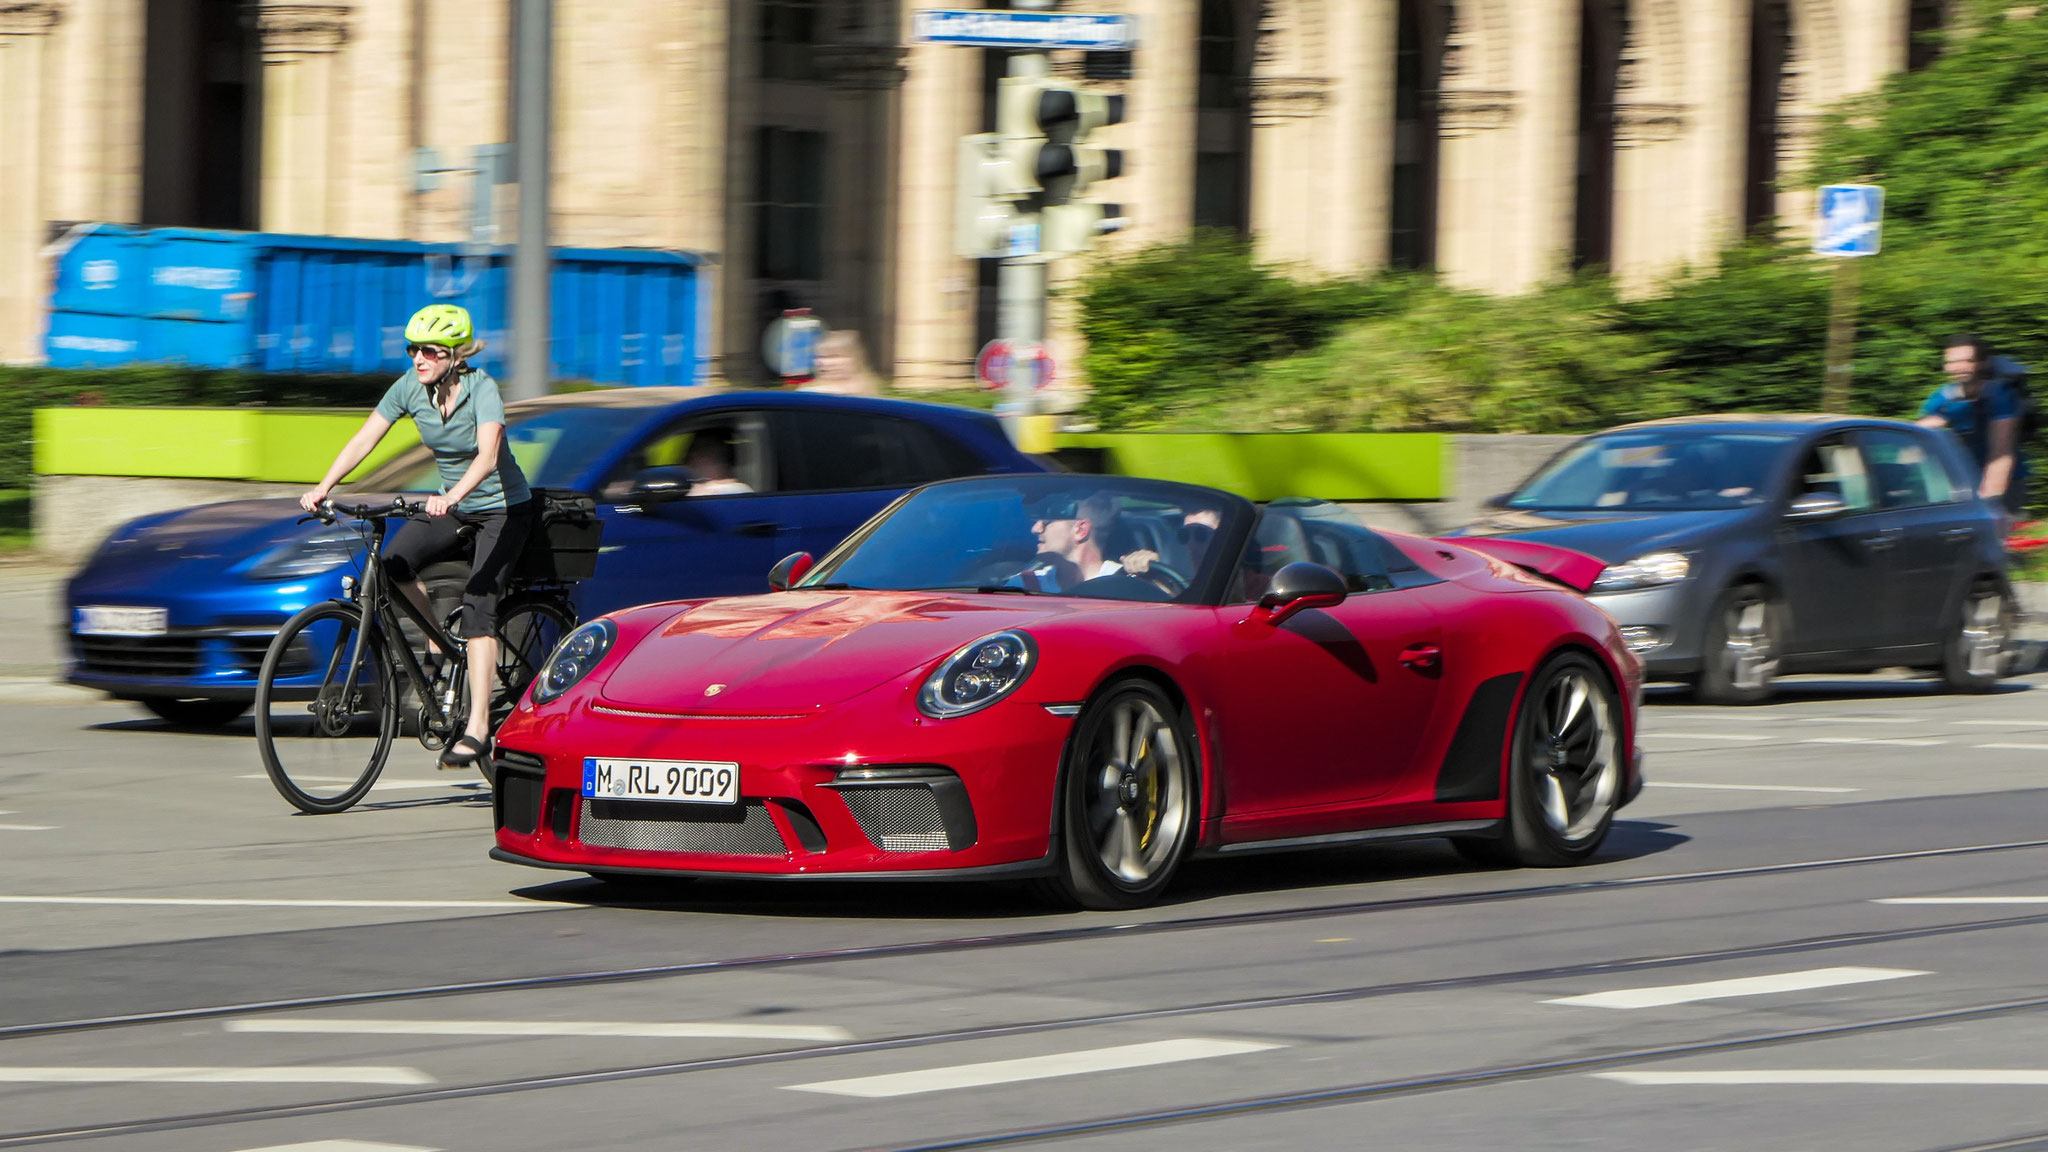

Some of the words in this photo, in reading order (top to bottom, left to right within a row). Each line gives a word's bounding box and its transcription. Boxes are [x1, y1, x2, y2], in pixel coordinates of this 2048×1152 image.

[586, 781, 593, 790] D
[597, 764, 612, 793] M
[628, 765, 660, 794] RL
[667, 767, 732, 797] 9009
